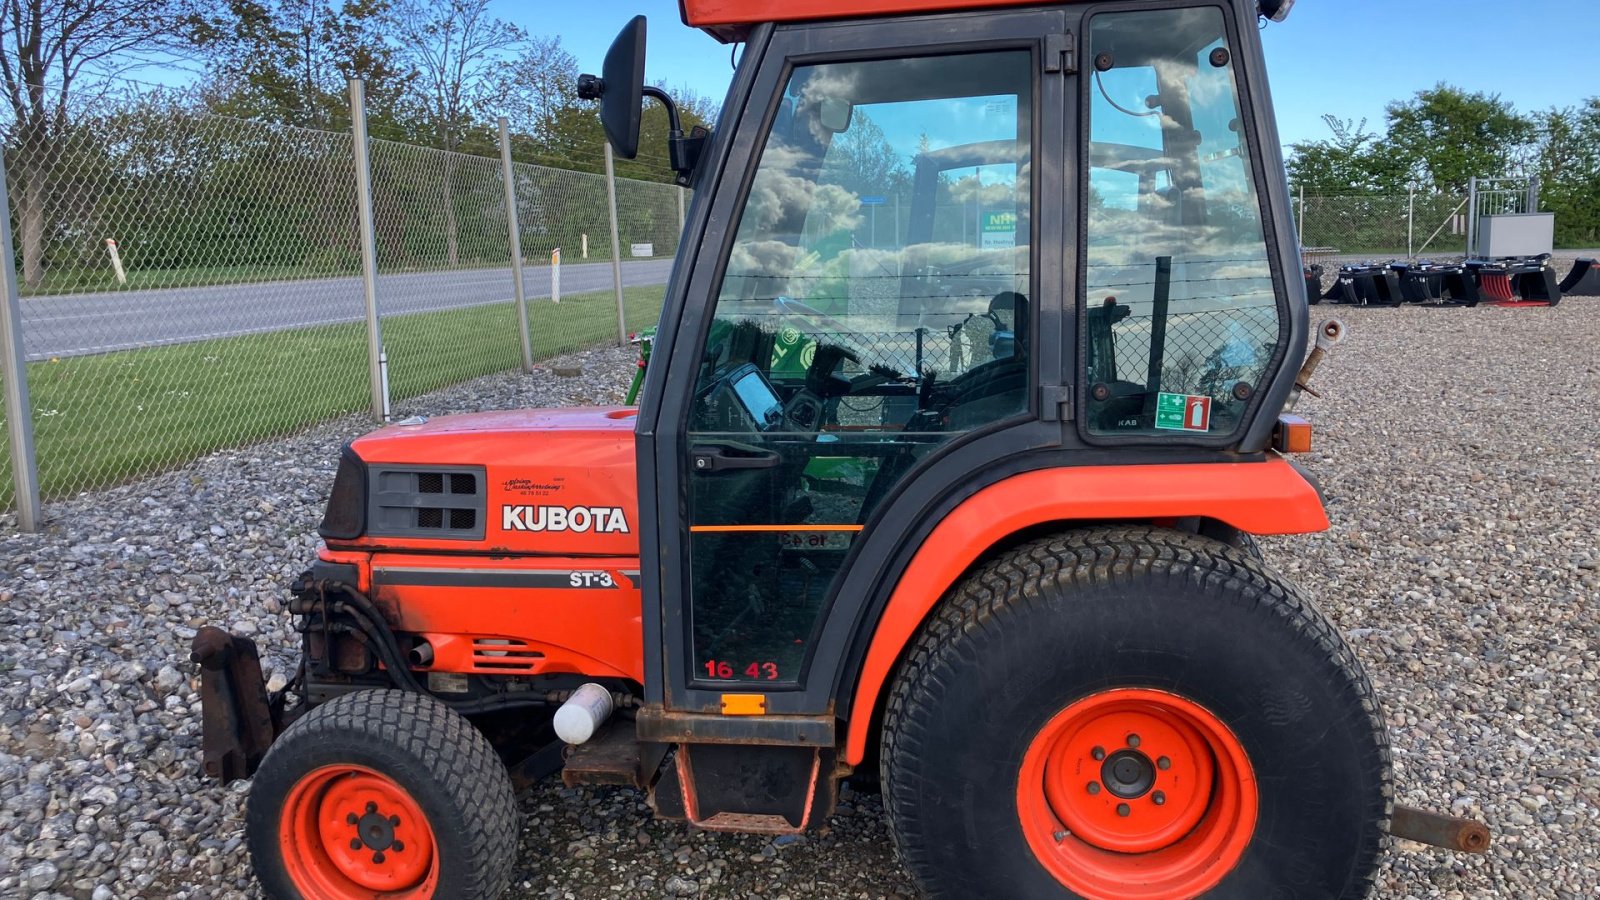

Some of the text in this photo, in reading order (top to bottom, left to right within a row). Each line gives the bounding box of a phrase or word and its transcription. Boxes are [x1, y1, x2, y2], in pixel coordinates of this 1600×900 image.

[502, 504, 630, 533] KUBOTA
[569, 571, 618, 588] ST-3
[704, 659, 779, 680] 16 43
